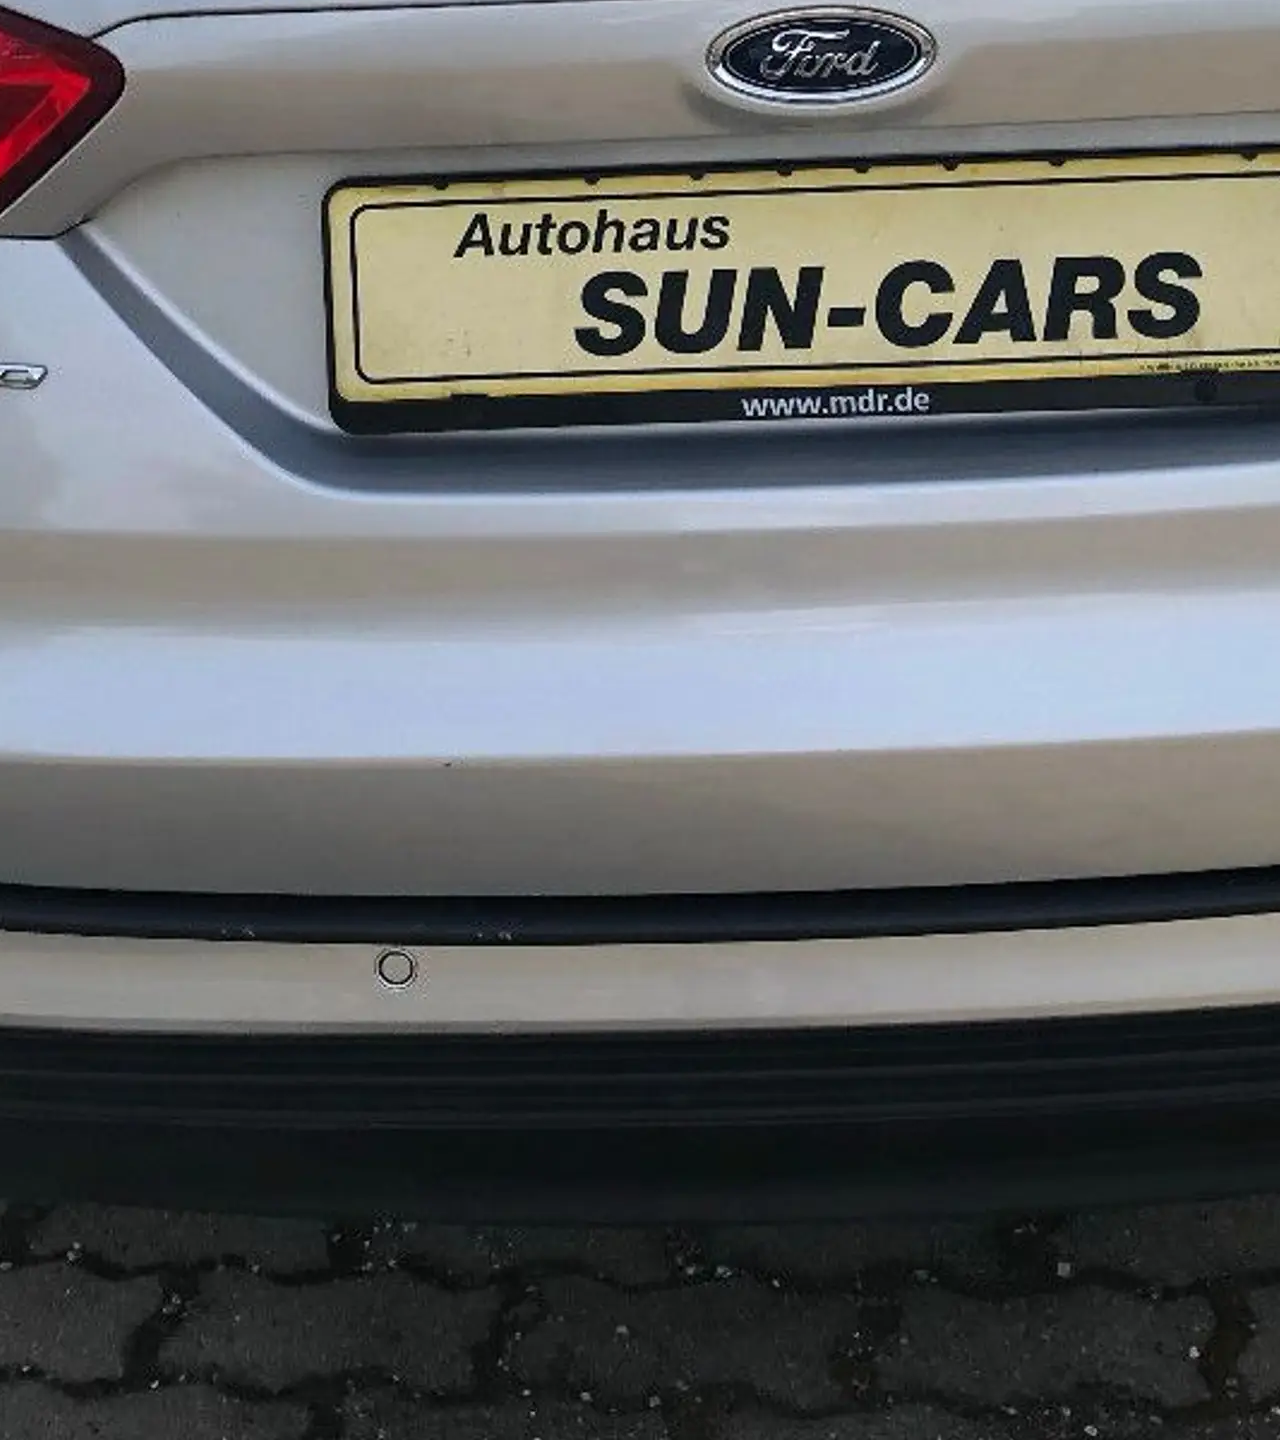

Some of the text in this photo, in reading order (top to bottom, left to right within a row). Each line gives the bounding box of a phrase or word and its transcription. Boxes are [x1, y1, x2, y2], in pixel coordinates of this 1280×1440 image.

[759, 29, 881, 80] Ford
[453, 209, 730, 258] Autohaus
[575, 252, 1202, 356] SUN-CARS
[741, 386, 930, 416] www.mdr.de
